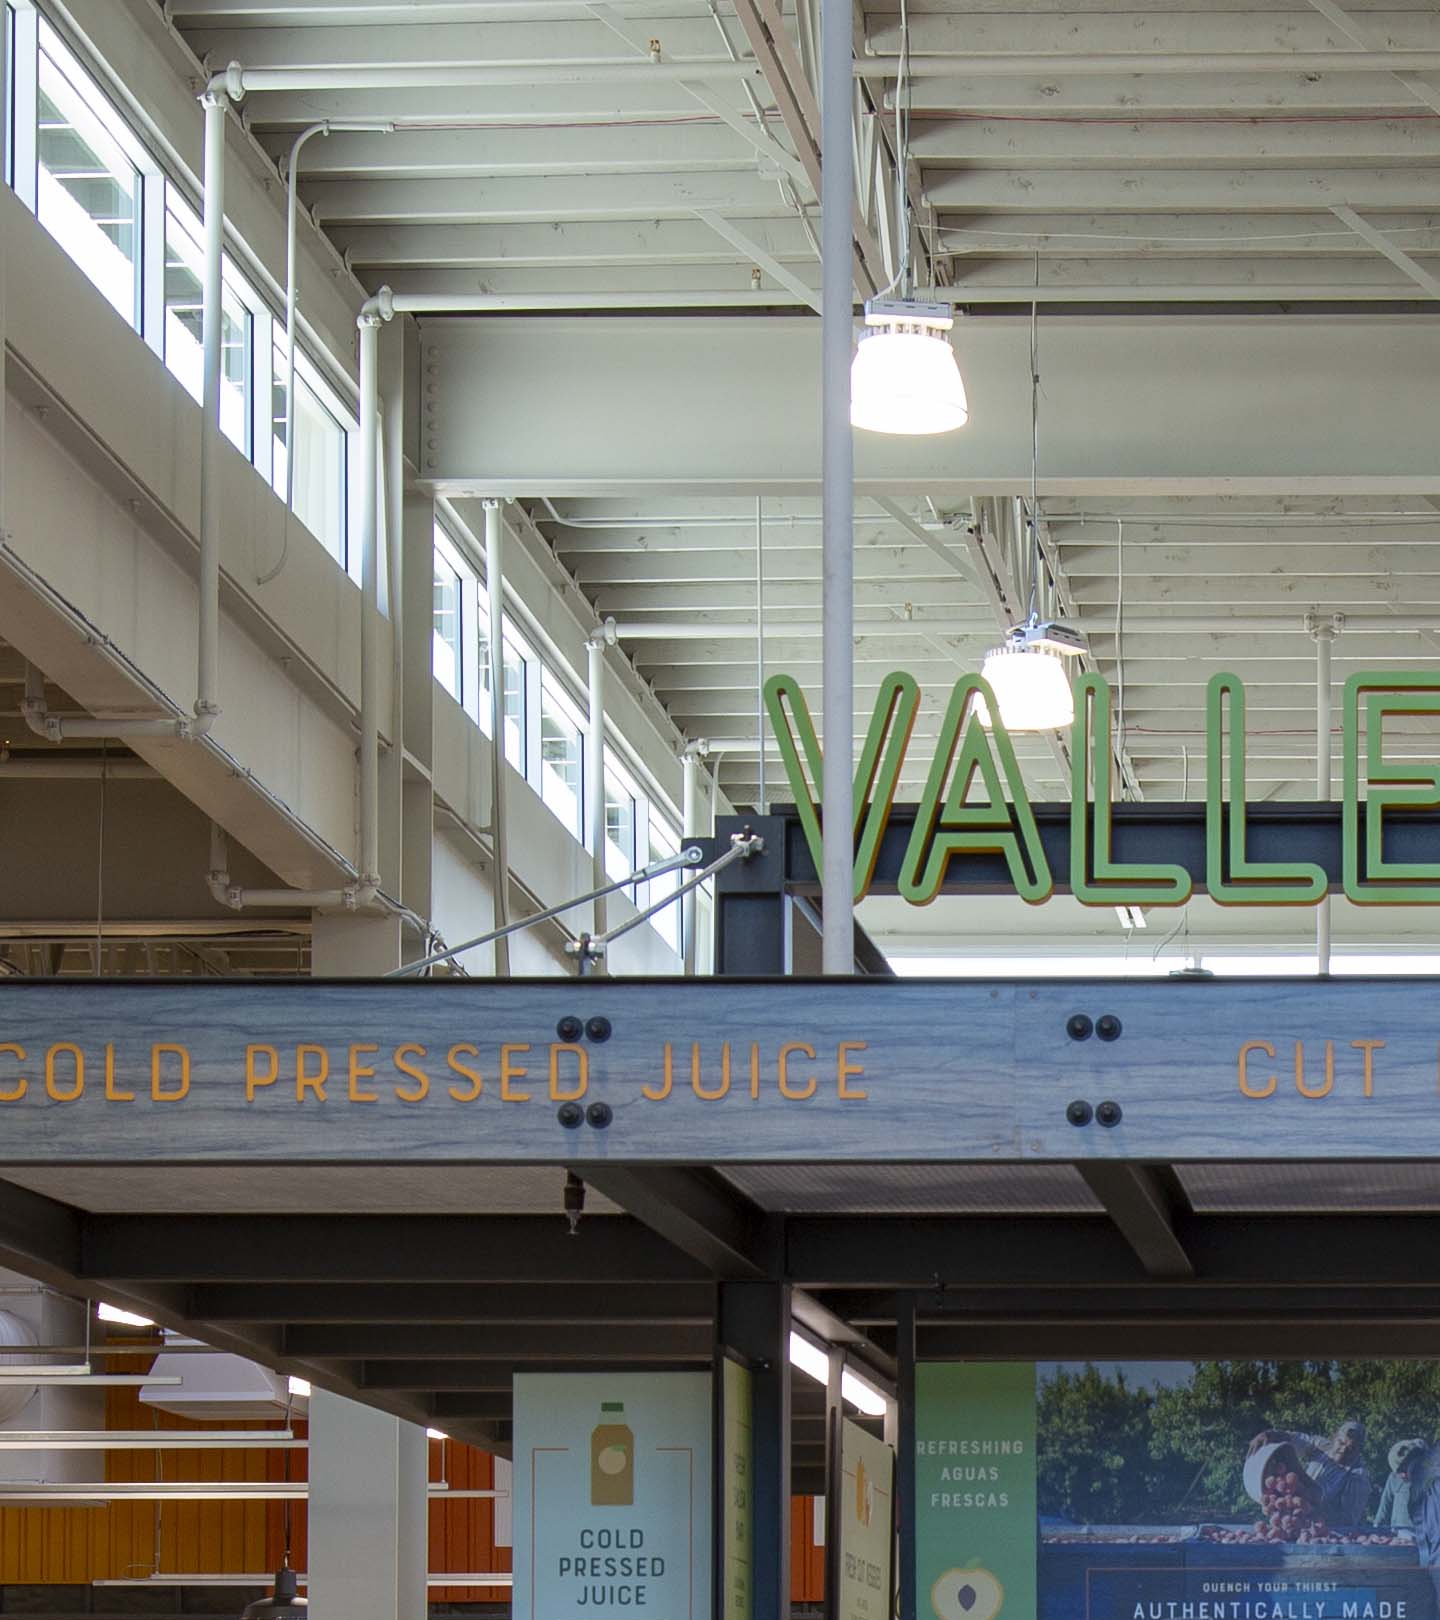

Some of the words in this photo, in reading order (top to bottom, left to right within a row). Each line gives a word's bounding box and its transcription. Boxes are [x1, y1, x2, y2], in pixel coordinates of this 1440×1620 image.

[244, 1041, 590, 1103] PRESSED
[641, 1040, 870, 1102] JUICE
[1237, 1040, 1386, 1099] CUT
[916, 1440, 1024, 1456] REFRESHING
[941, 1466, 999, 1482] AGUAS
[930, 1492, 1010, 1508] FRESCAS
[579, 1528, 644, 1550] COLD
[560, 1557, 665, 1578] PRESSED
[576, 1585, 647, 1606] JUICE
[1202, 1581, 1252, 1593] QUENCH
[1257, 1581, 1290, 1593] YOUR
[1294, 1581, 1338, 1593] THIRST
[1133, 1600, 1326, 1620] AUTHENTICALLY
[1342, 1600, 1407, 1620] MADE
